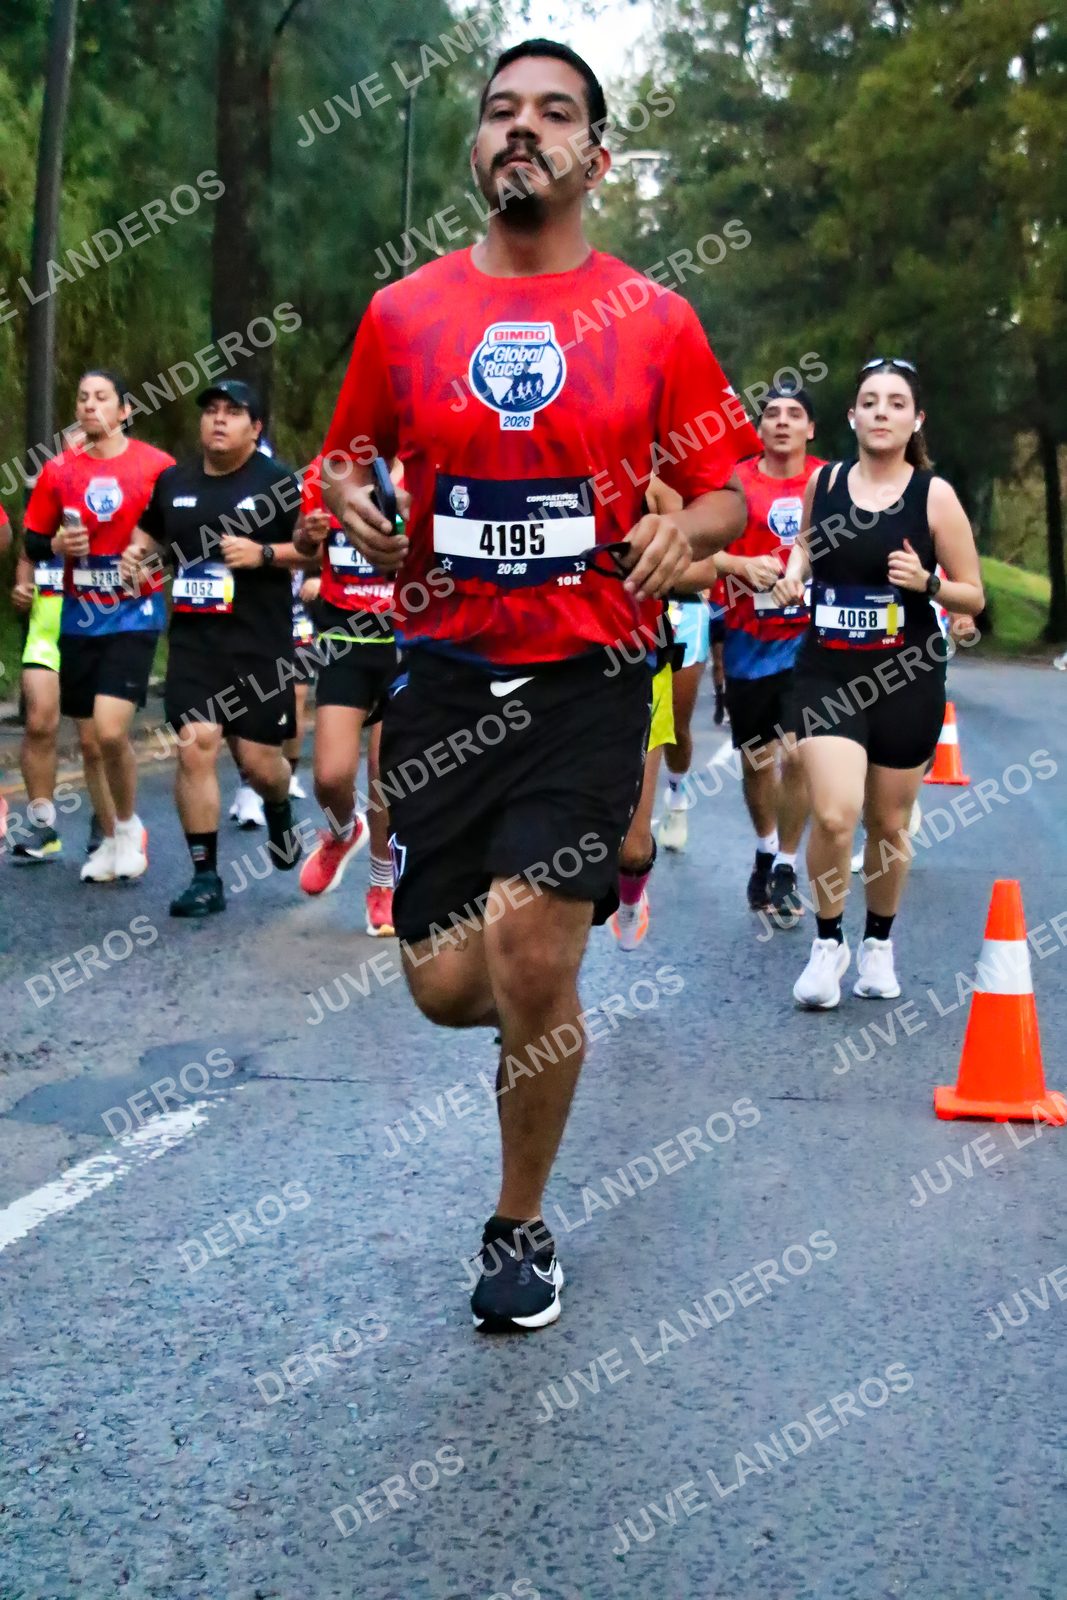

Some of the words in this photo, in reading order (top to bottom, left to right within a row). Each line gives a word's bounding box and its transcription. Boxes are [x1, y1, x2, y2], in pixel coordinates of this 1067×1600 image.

[494, 330, 545, 341] BIMBO
[493, 345, 544, 362] Global
[483, 361, 524, 378] Race
[503, 416, 531, 428] 2026
[479, 523, 545, 556] 4195
[496, 563, 527, 575] 20-26
[557, 575, 582, 586] 10K
[838, 609, 878, 628] 4068
